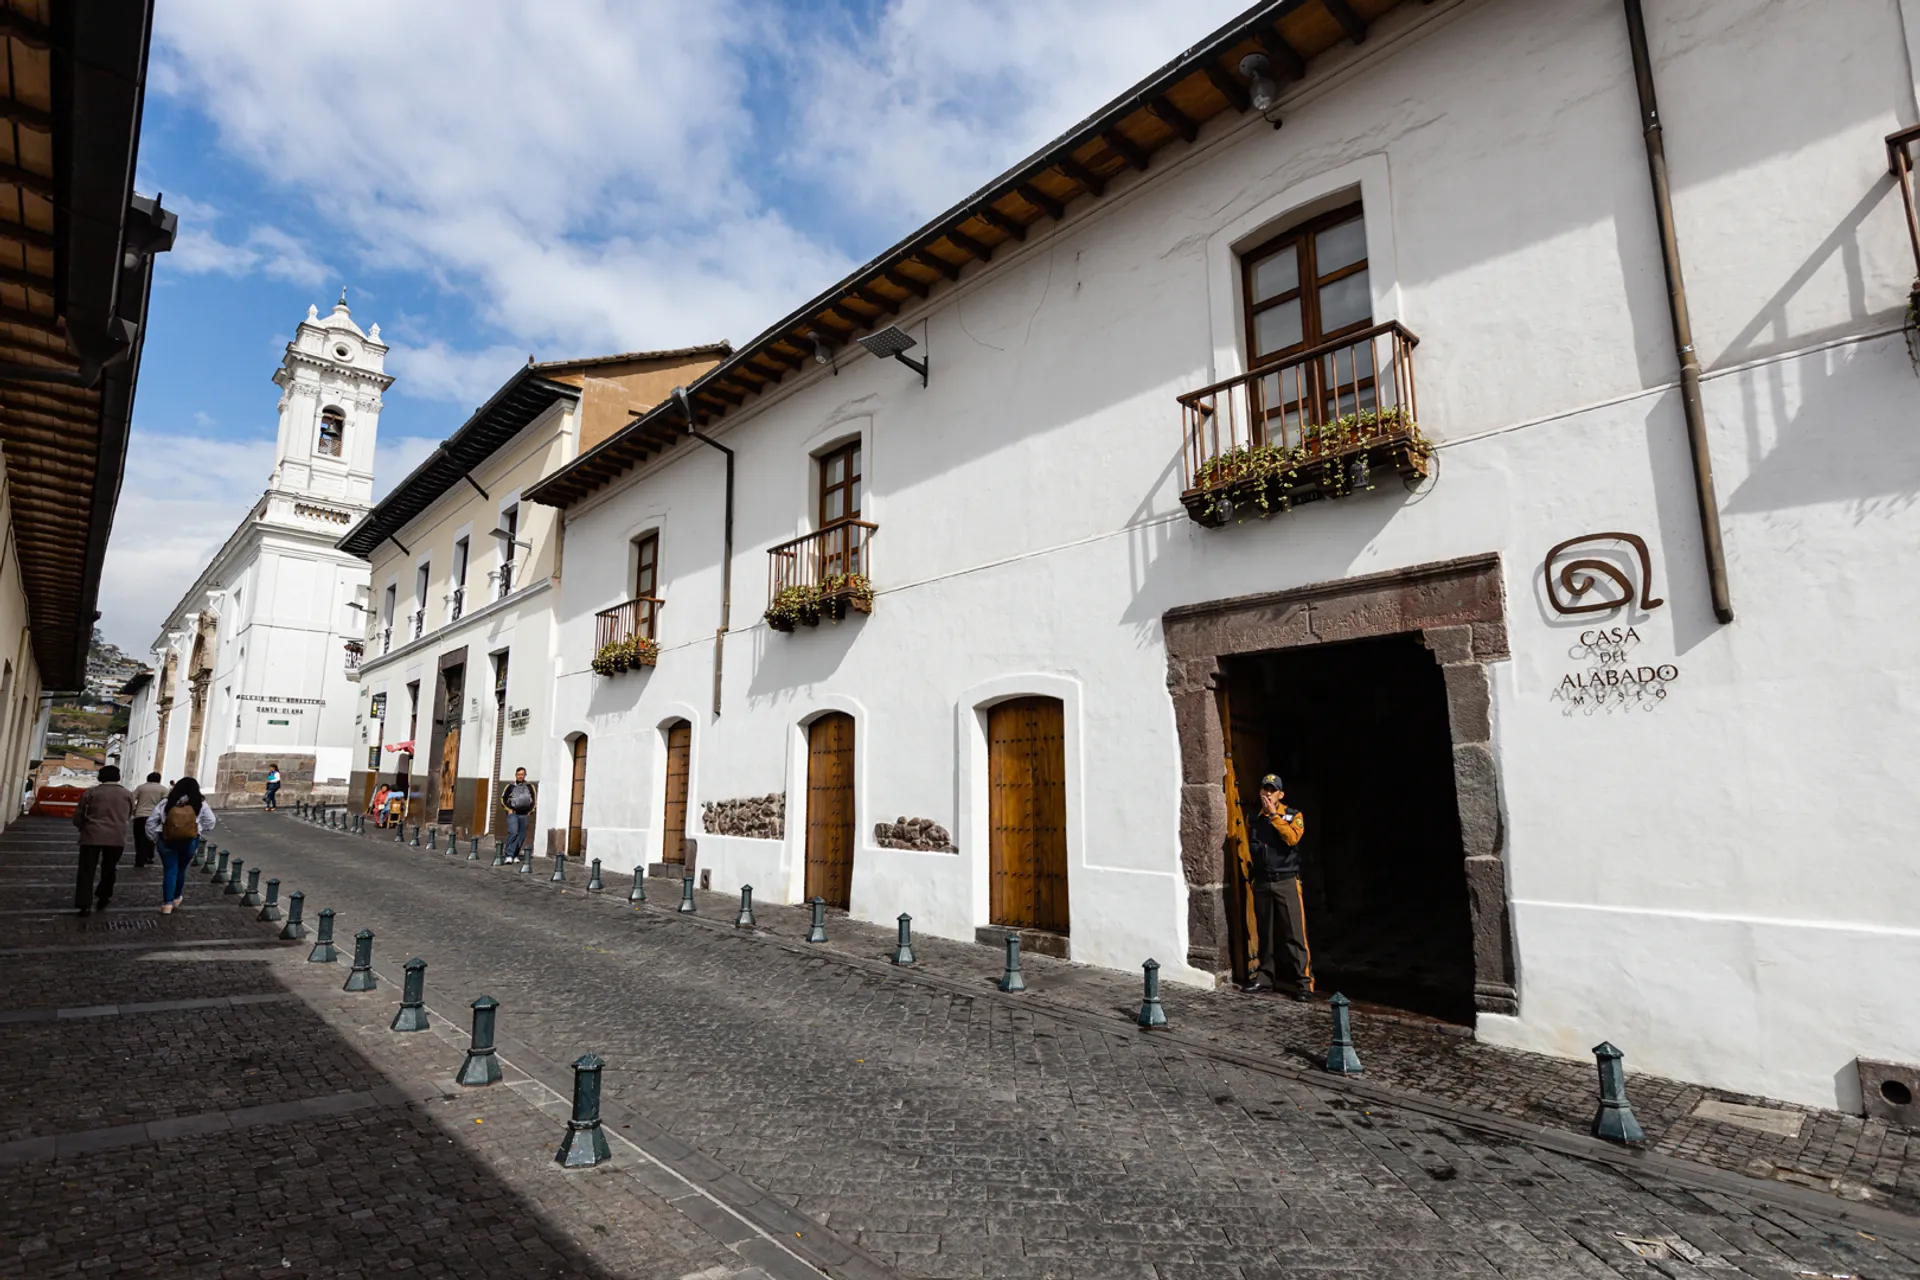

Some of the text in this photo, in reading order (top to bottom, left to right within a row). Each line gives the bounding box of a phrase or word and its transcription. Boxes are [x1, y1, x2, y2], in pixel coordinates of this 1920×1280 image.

[1580, 626, 1641, 646] CASA
[1600, 651, 1627, 663] DEL
[1561, 664, 1679, 689] ALABADO
[1573, 688, 1667, 705] MUSEO
[256, 706, 304, 715] SANTA CLARA
